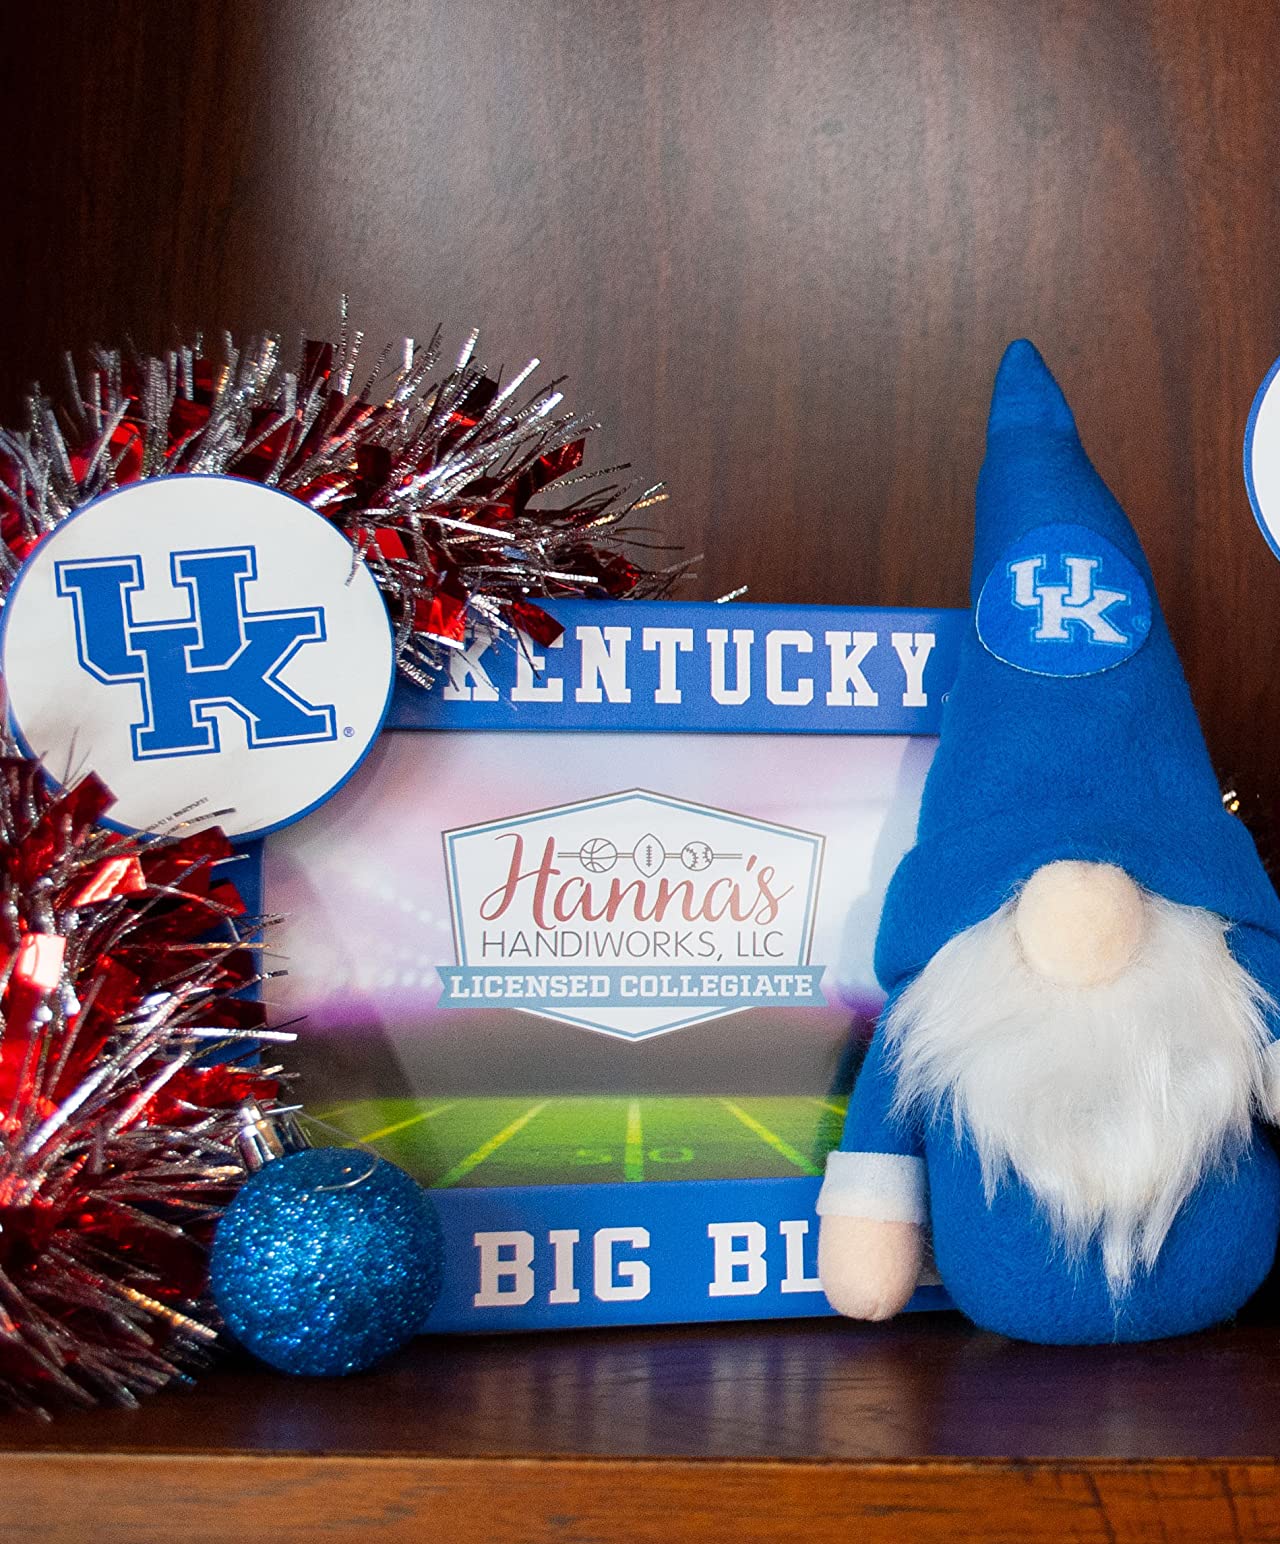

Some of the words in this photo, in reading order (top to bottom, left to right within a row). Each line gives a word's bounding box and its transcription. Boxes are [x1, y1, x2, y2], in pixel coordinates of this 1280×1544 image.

[1007, 553, 1133, 648] UK
[54, 545, 337, 761] UK
[443, 625, 936, 707] KENTUCKY
[479, 833, 795, 930] Hanna's
[450, 975, 611, 999] LICENSED
[620, 974, 813, 998] COLLEGIATE
[481, 930, 723, 962] HANDIWORKS,
[737, 930, 785, 958] LLC
[474, 1226, 651, 1307] BIG
[708, 1220, 826, 1297] BL
